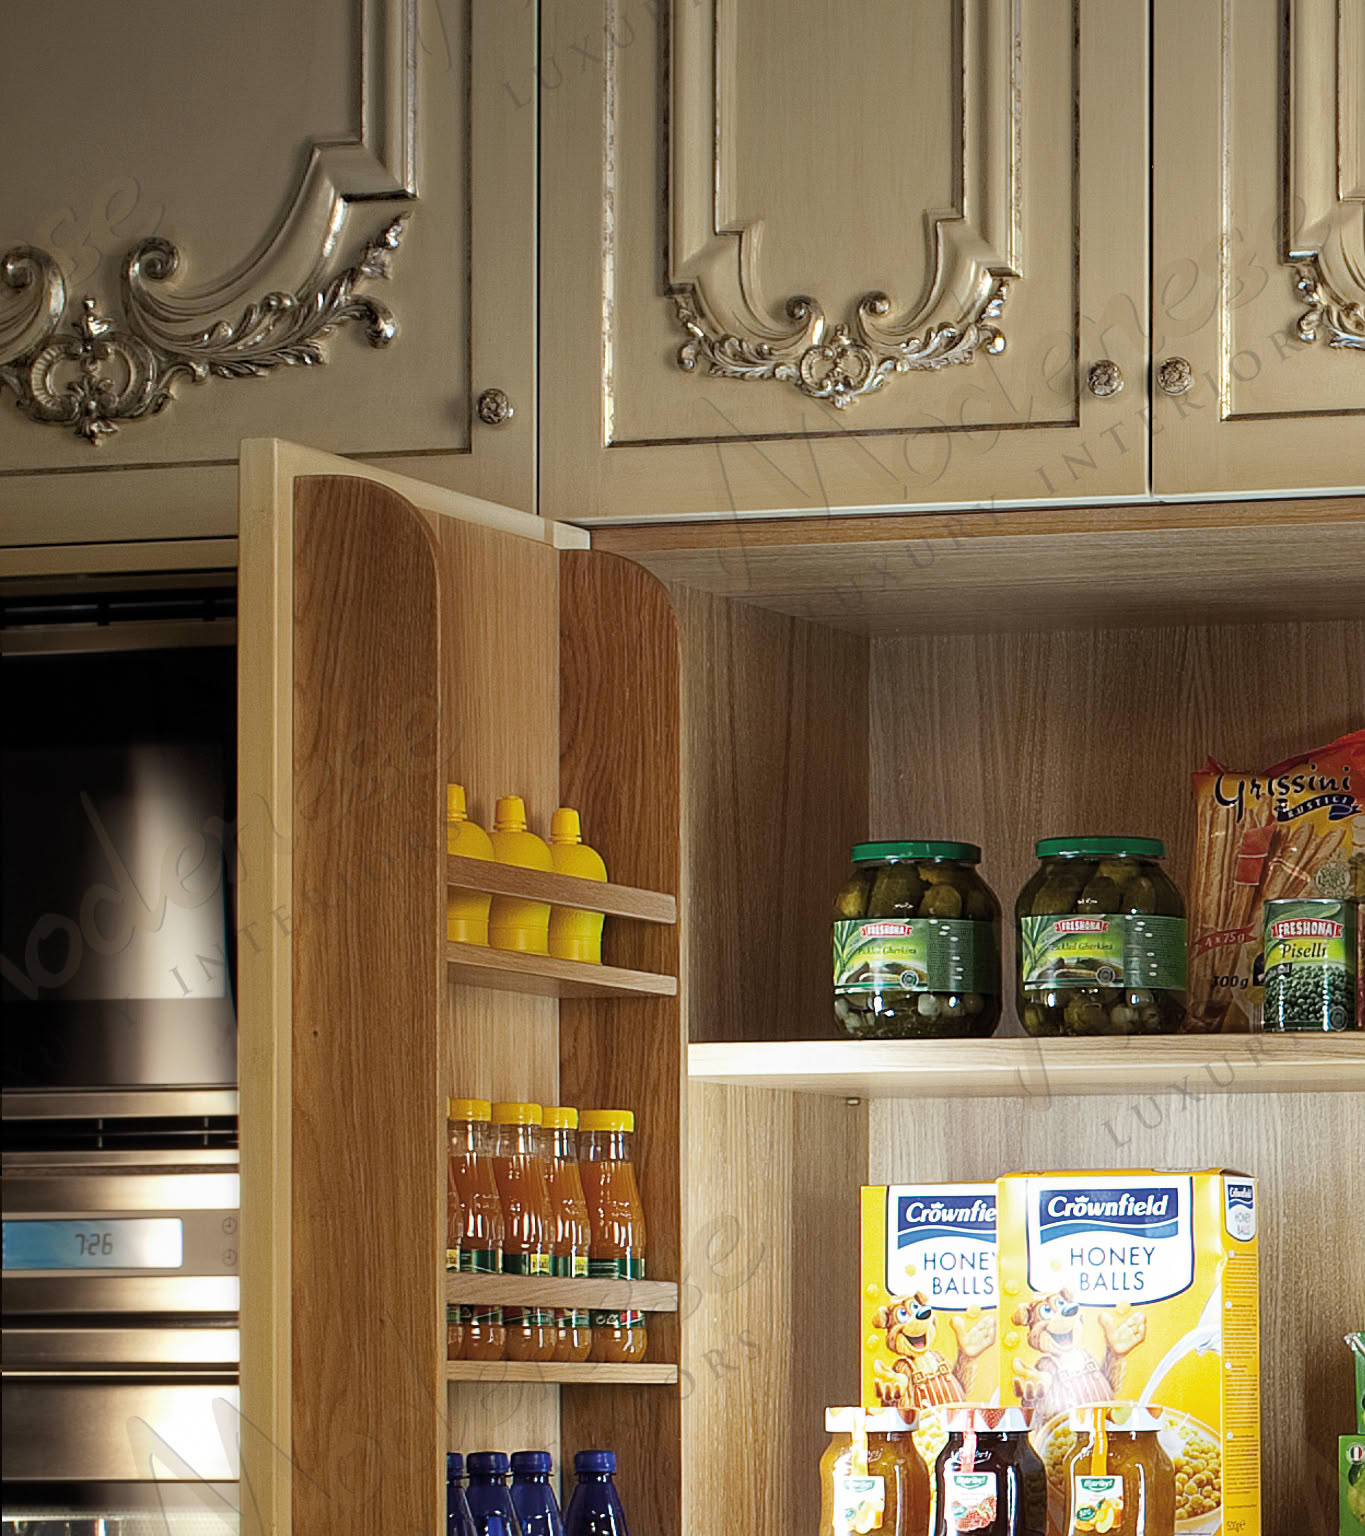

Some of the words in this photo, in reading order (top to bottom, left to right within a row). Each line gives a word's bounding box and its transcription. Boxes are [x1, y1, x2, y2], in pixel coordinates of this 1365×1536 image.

[1278, 920, 1334, 936] FRESHONA
[905, 1200, 996, 1223] Crownfie
[1047, 1194, 1169, 1217] Crownfield
[923, 1251, 996, 1272] HONE
[1070, 1246, 1156, 1267] HONEY
[932, 1276, 994, 1295] BALLS
[1079, 1271, 1145, 1291] BALLS
